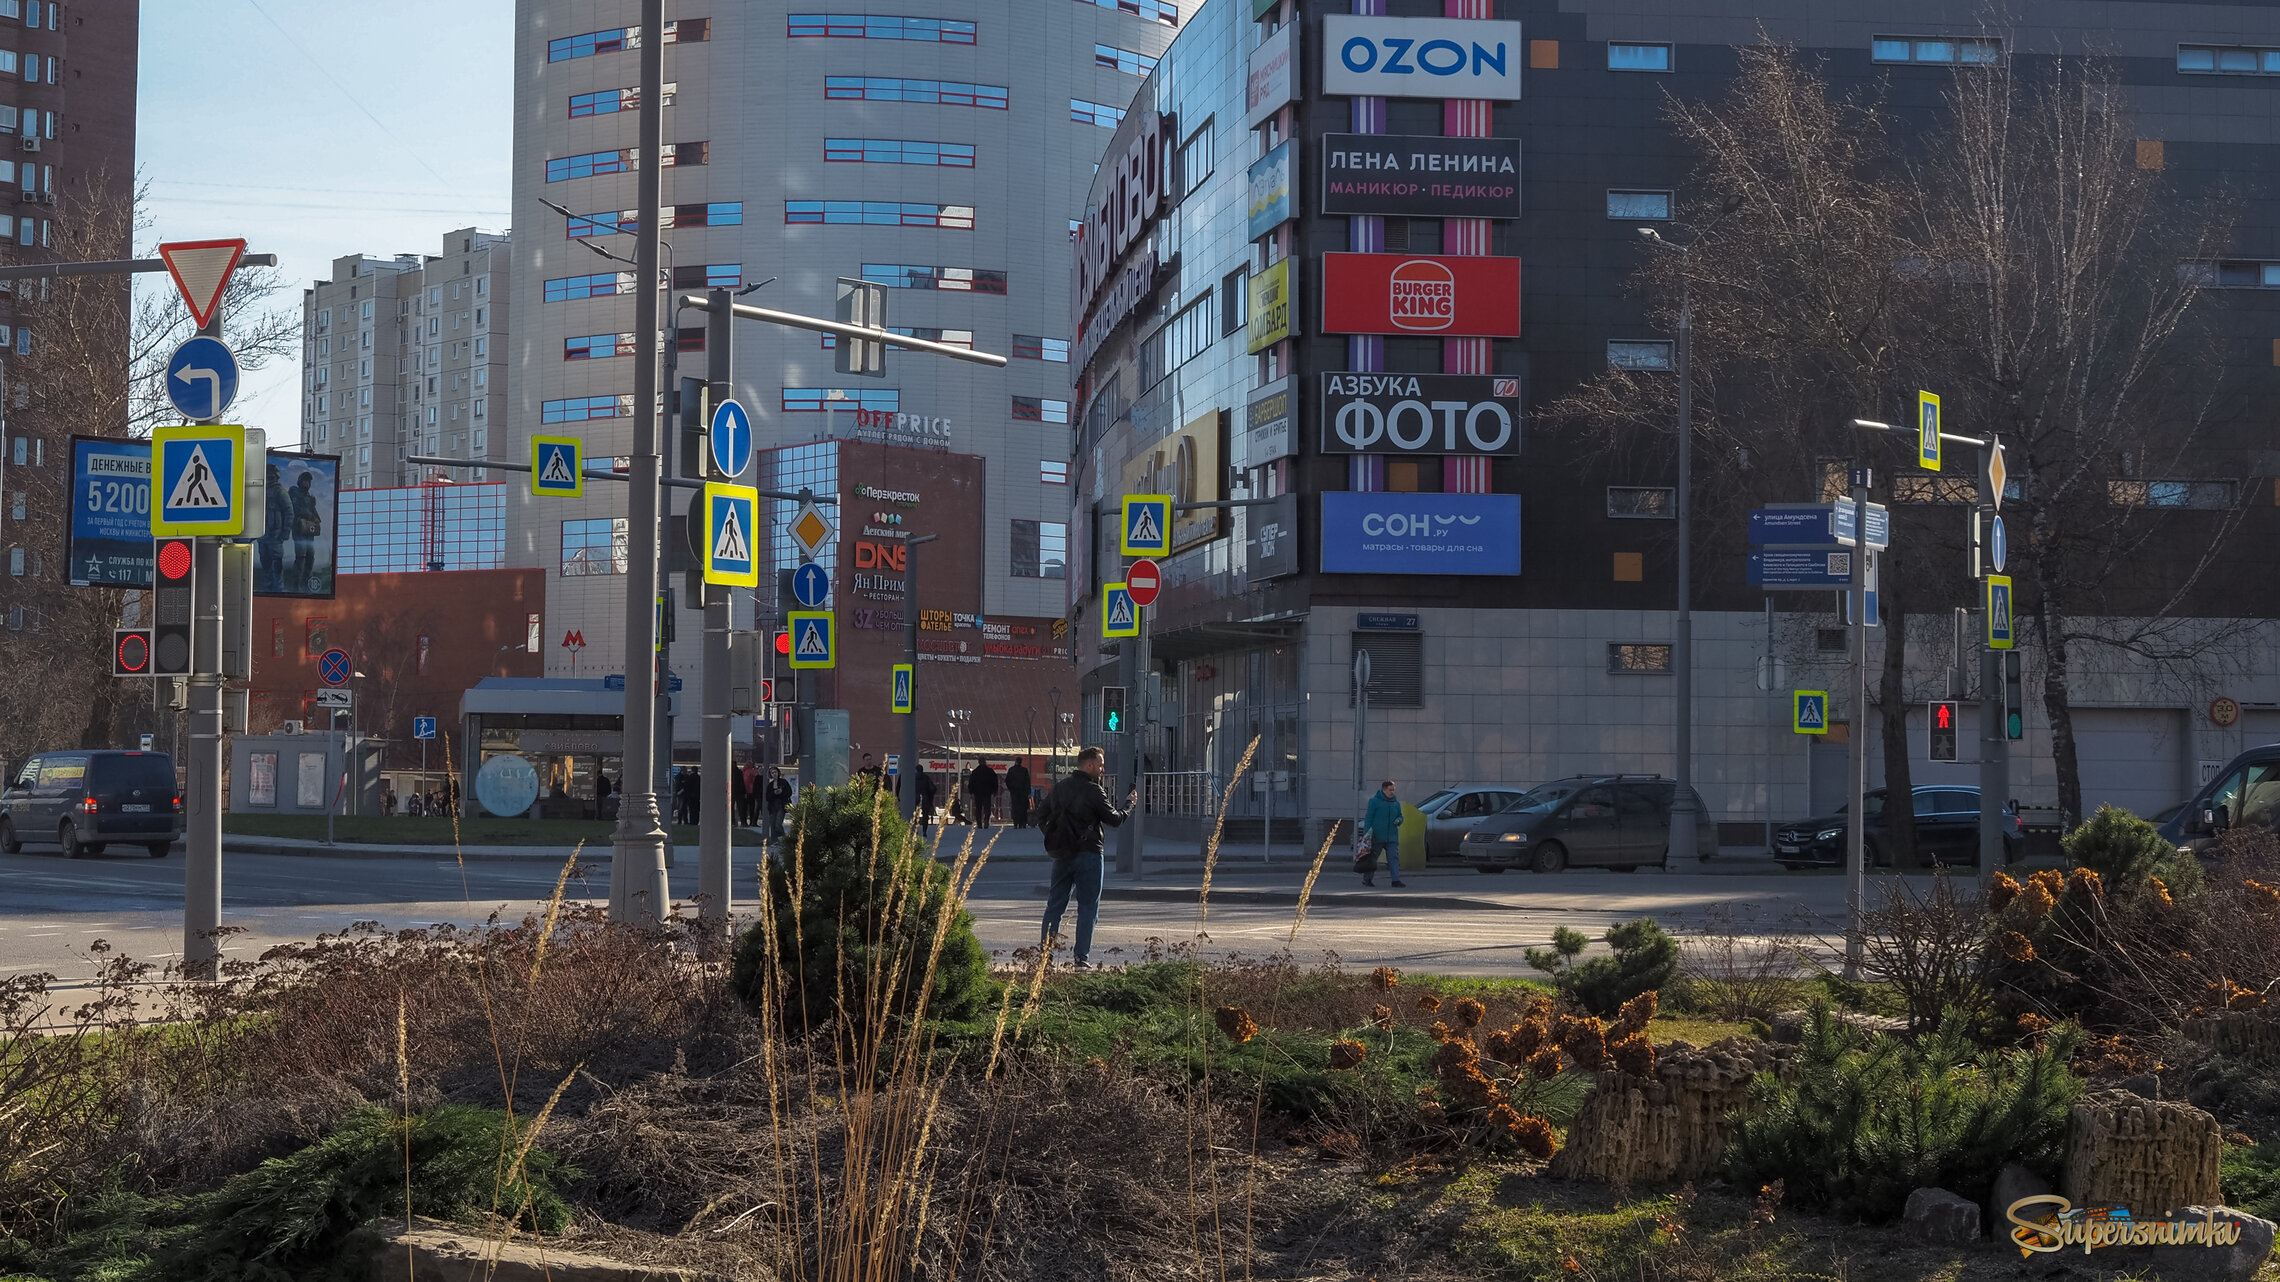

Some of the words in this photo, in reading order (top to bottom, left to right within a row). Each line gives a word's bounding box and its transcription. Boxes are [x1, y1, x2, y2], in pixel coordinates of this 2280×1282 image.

[1341, 37, 1506, 77] OZON
[1330, 152, 1399, 170] ЛЕНА
[1410, 154, 1515, 174] ЛЕНИНА
[1330, 182, 1418, 196] МАНИКЮР
[1431, 184, 1514, 199] ПЕДИКЮР
[1393, 282, 1452, 297] BURGER
[1393, 296, 1452, 316] KING
[1249, 302, 1288, 344] ЛОМБАРД
[1328, 375, 1422, 397] АЗБУКА
[1335, 397, 1512, 451] ФОТО
[857, 429, 885, 440] АУТЛЕТ
[888, 432, 913, 444] РЯДОМ
[916, 436, 921, 444] С
[923, 437, 951, 447] ДОМОМ
[91, 458, 143, 473] ДЕНЕЖНЫЕ
[1362, 513, 1430, 537] СОН
[1783, 514, 1817, 522] Амундсена
[100, 528, 119, 536] МОСКВЫ
[863, 525, 894, 537] Детский
[1362, 544, 1404, 552] матрасы
[1410, 544, 1445, 553] товары
[109, 557, 134, 566] СЛУЖБА
[119, 569, 131, 581] 117
[852, 573, 870, 594] Ян
[873, 574, 905, 591] Прим
[869, 592, 899, 601] РЕСТОРАН
[880, 610, 904, 620] БОЛЬШ
[920, 609, 953, 622] ШТОРЫ
[953, 613, 975, 623] ТОЧКА
[1406, 618, 1416, 626] 27
[983, 623, 1011, 634] РЕМОНТ
